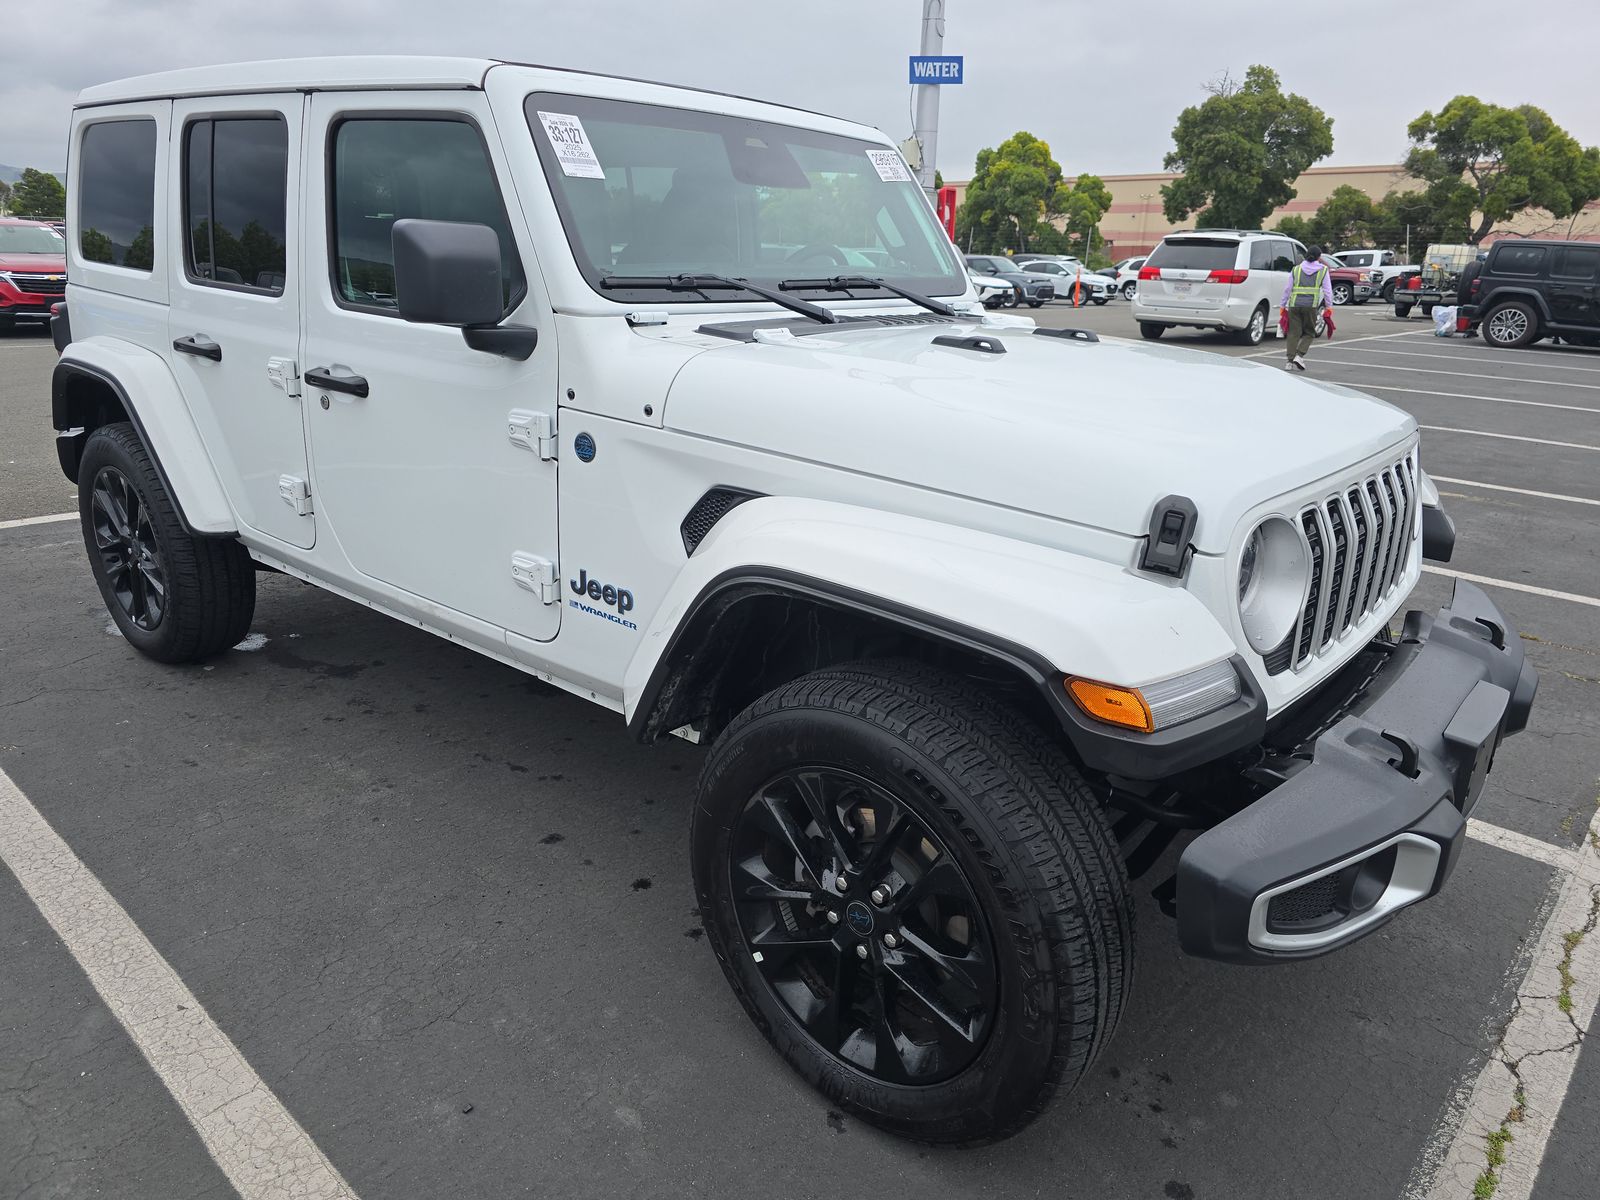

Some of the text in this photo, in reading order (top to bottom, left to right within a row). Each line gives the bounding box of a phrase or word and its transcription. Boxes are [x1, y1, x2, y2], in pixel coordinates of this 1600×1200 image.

[913, 62, 959, 77] WATER
[548, 125, 584, 145] 33:127
[563, 143, 582, 151] 2025
[570, 568, 634, 615] Jeep
[579, 602, 637, 631] WRANGLER
[904, 767, 1020, 912] ROADIAN
